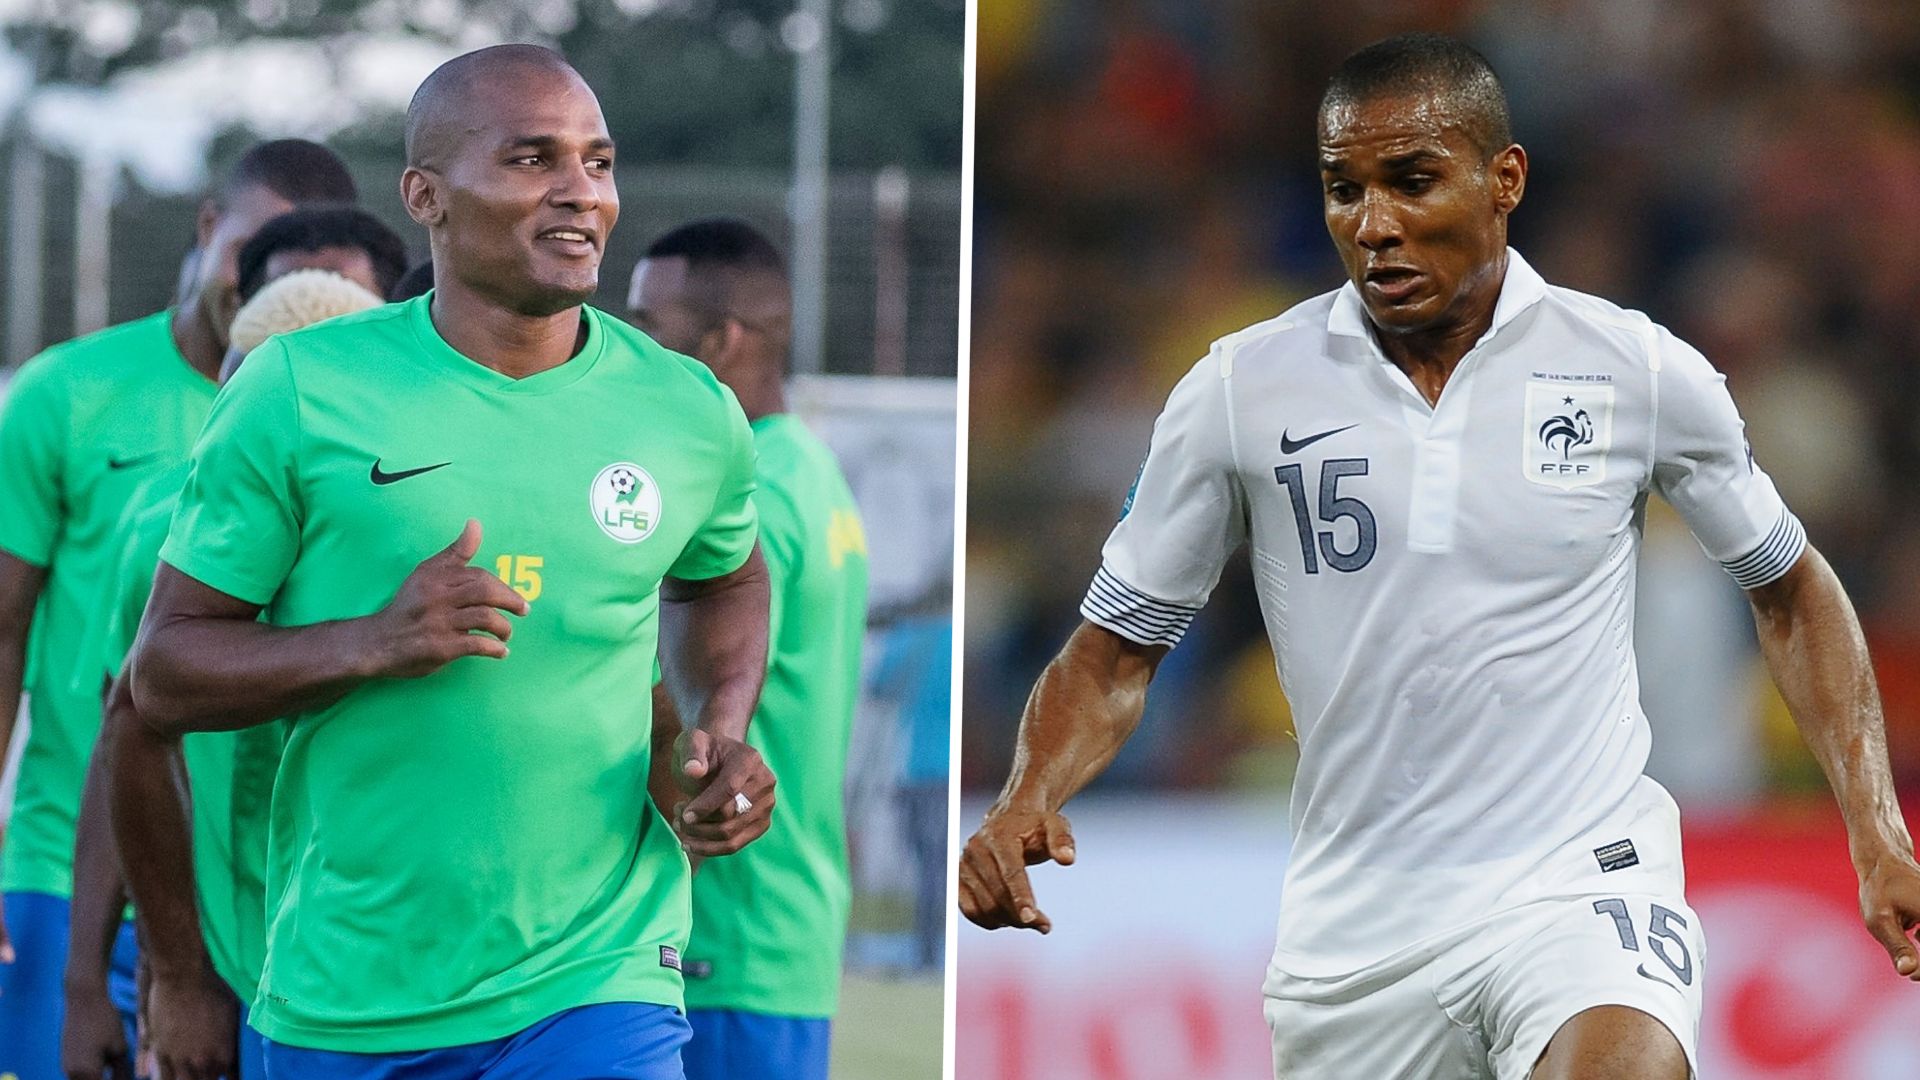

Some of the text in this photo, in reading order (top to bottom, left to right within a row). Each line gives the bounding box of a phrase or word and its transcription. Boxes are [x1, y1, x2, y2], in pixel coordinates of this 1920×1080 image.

[1541, 463, 1590, 475] FFF
[1274, 458, 1377, 574] 15
[496, 554, 544, 602] 15
[1592, 898, 1692, 986] 15
